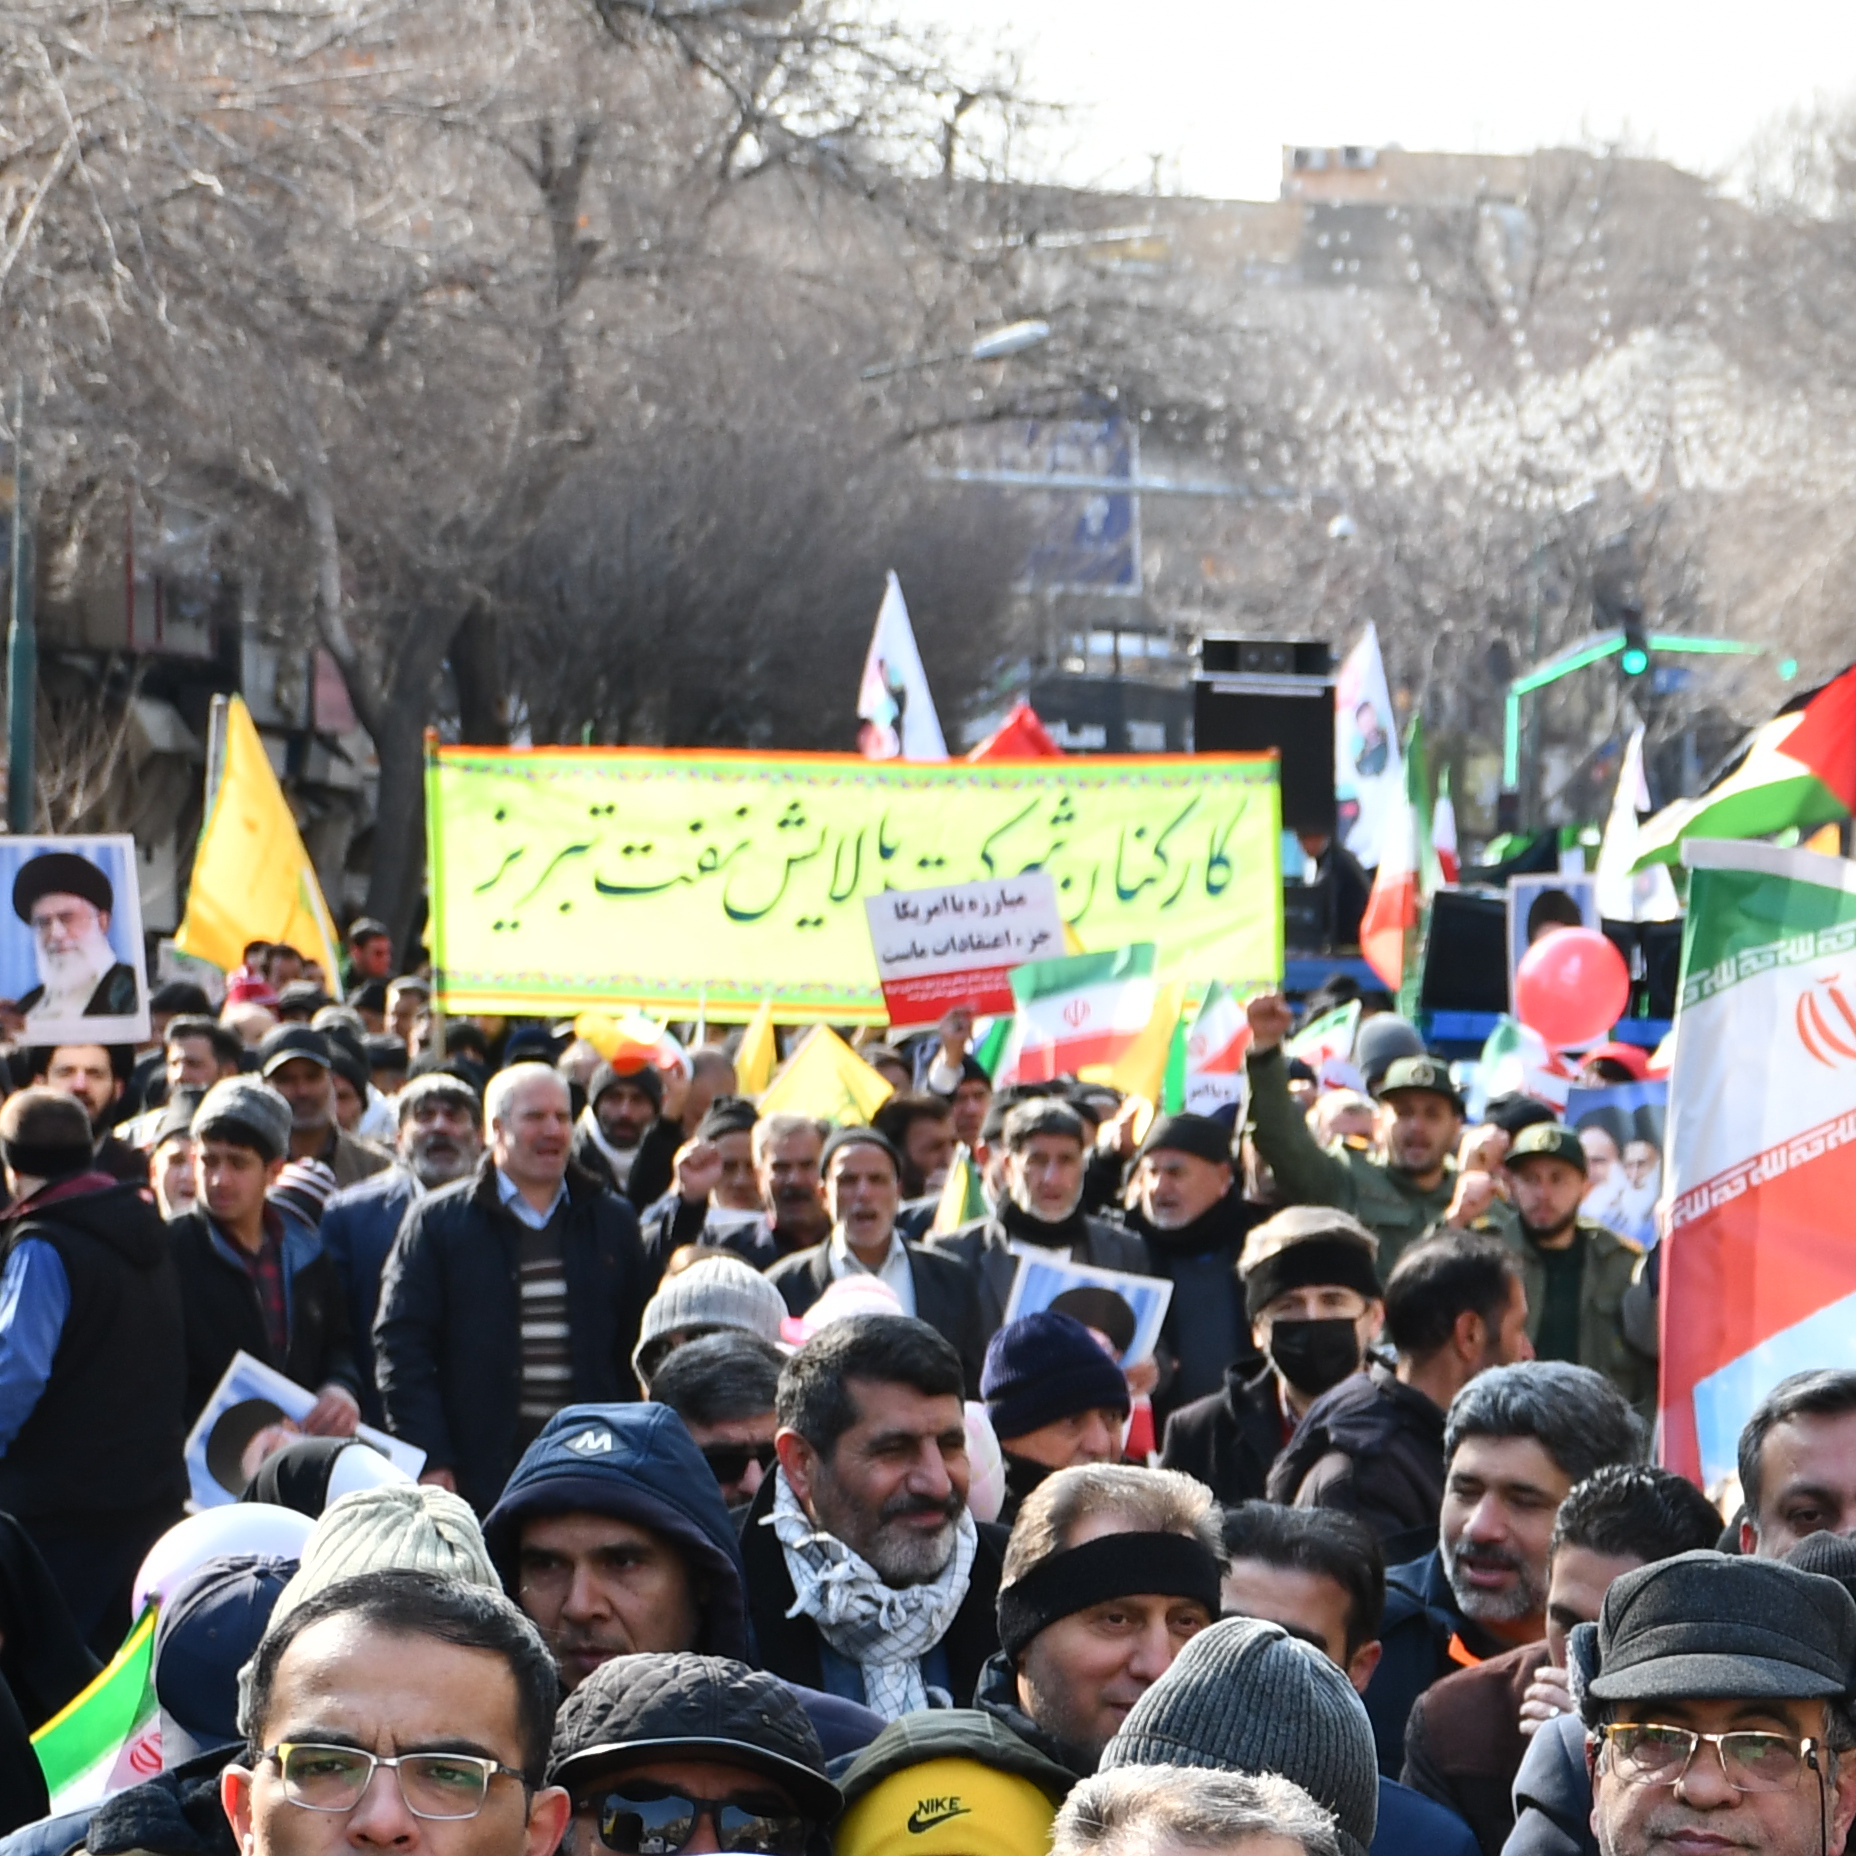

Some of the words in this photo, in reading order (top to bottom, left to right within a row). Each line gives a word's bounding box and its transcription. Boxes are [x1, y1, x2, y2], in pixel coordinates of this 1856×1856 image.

[474, 802, 617, 932] تبریز
[594, 805, 751, 896] نفت
[967, 888, 1027, 918] مبارزه
[916, 1796, 962, 1816] NIKE
